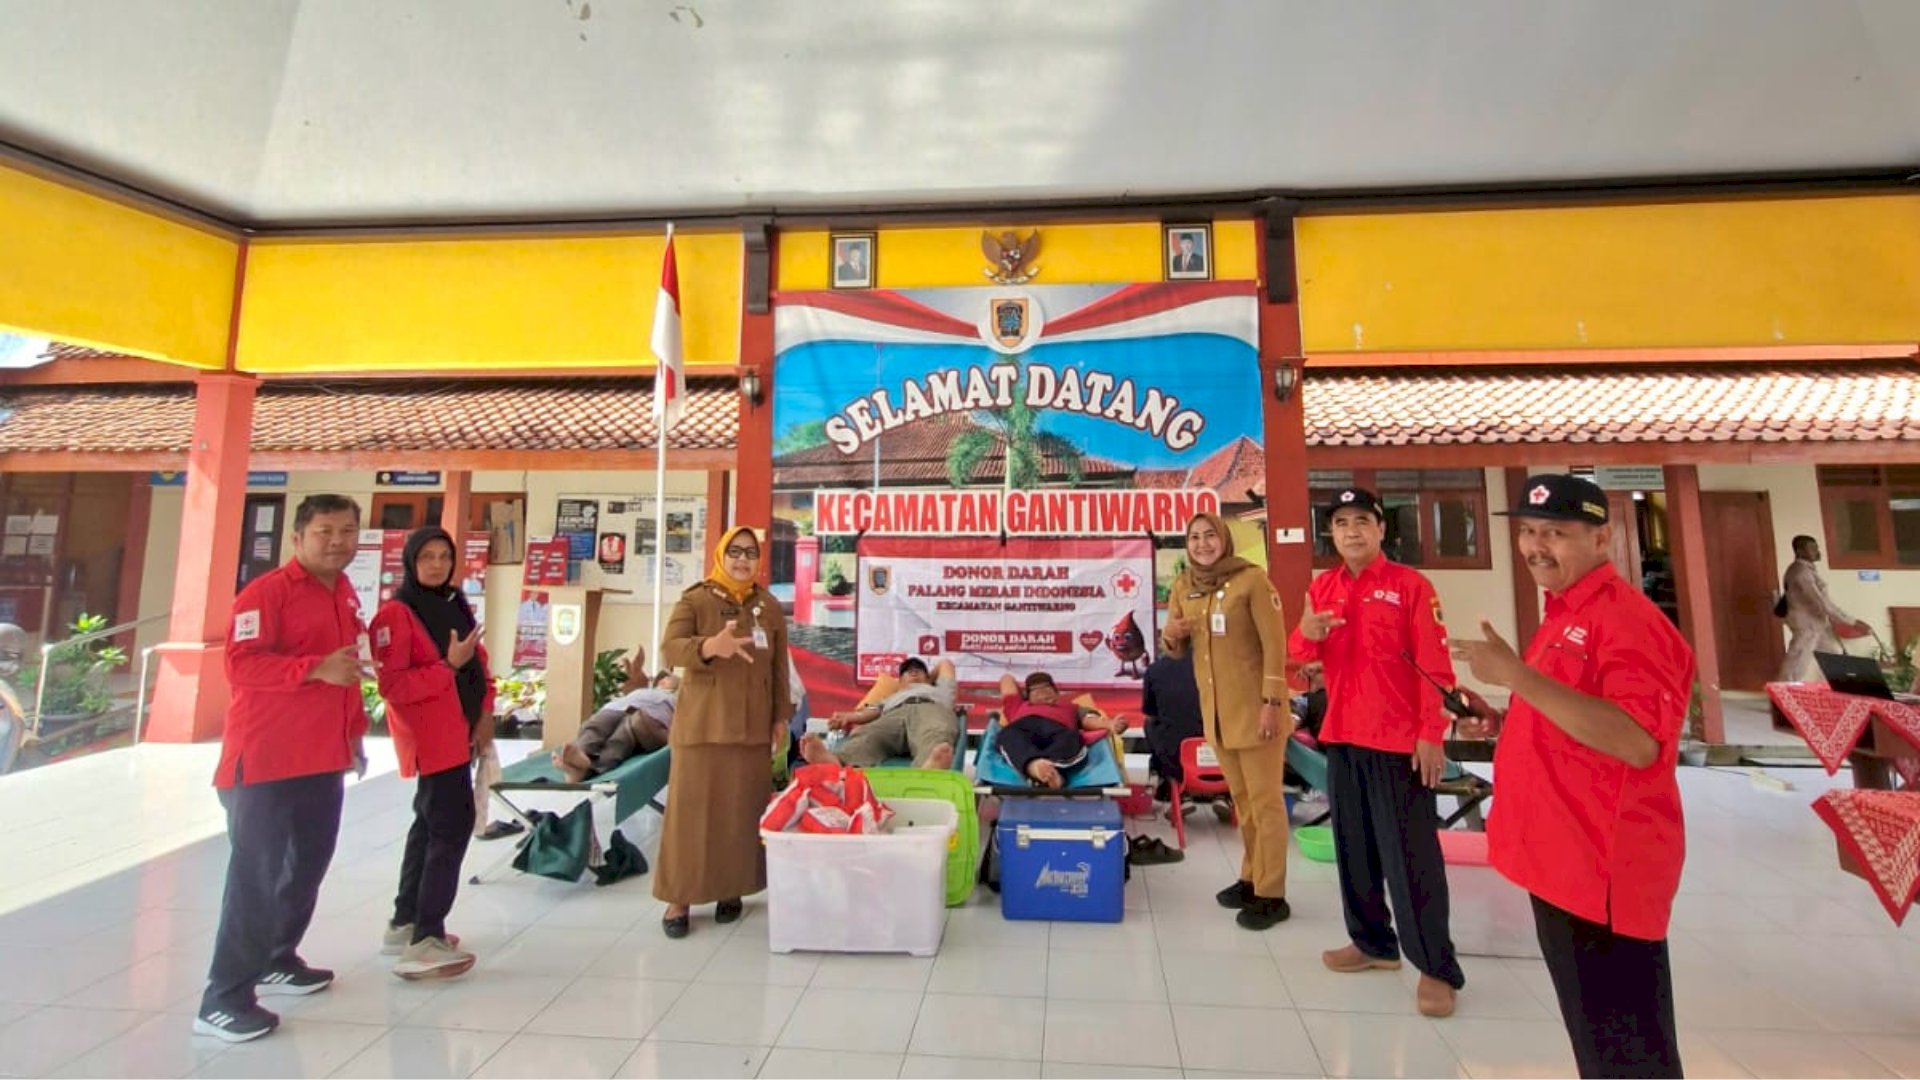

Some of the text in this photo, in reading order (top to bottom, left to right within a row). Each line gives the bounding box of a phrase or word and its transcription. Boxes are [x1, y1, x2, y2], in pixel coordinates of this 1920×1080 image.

[825, 364, 1204, 455] SELAMAT DATANG
[816, 493, 998, 532] KECAMATAN
[943, 565, 1069, 579] DONOR DARAH
[908, 585, 1106, 598] PALANG MERAH INDONESIA
[961, 634, 1056, 644] DONOR DARAH
